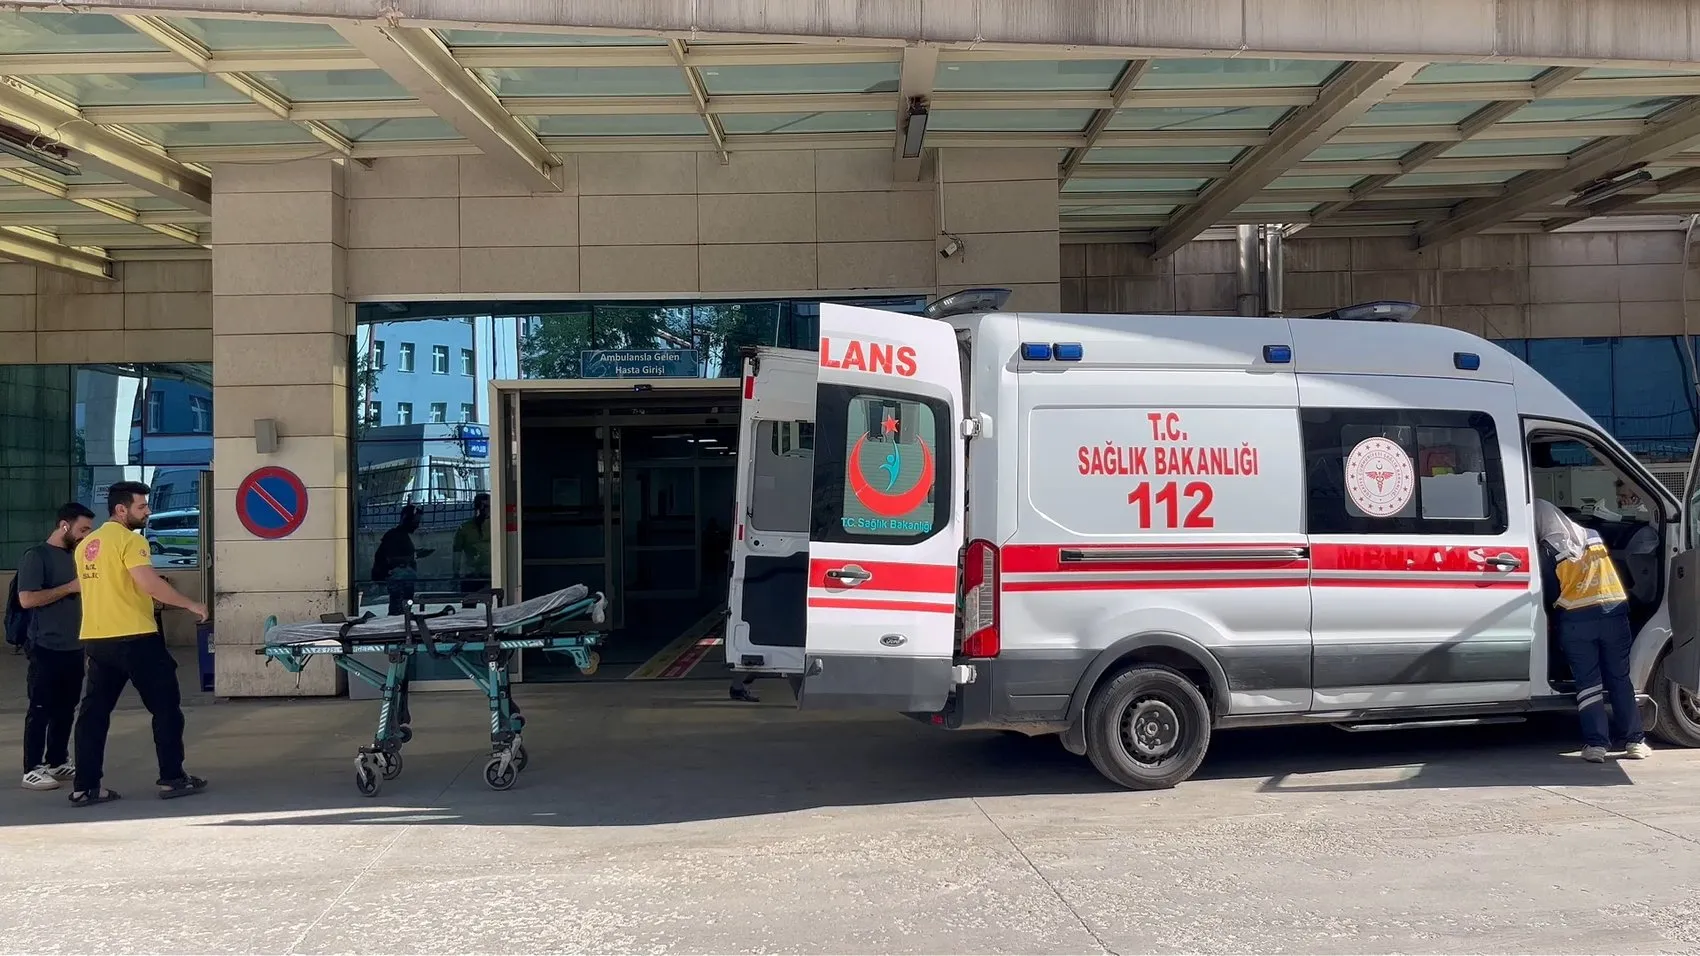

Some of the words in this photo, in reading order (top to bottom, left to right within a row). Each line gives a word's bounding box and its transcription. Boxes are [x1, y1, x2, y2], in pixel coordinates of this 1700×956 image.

[600, 353, 652, 361] Ambulansla
[654, 353, 680, 361] Gelen
[615, 366, 640, 374] Hasta
[642, 366, 665, 375] Girişi
[820, 337, 917, 376] LANS
[1147, 412, 1188, 441] T.C.
[1078, 440, 1149, 476] SAĞLIK
[1154, 441, 1259, 476] BAKANLIĞI
[1127, 481, 1214, 529] 112
[858, 518, 887, 530] Sağlık
[890, 520, 932, 533] Bakanlığı
